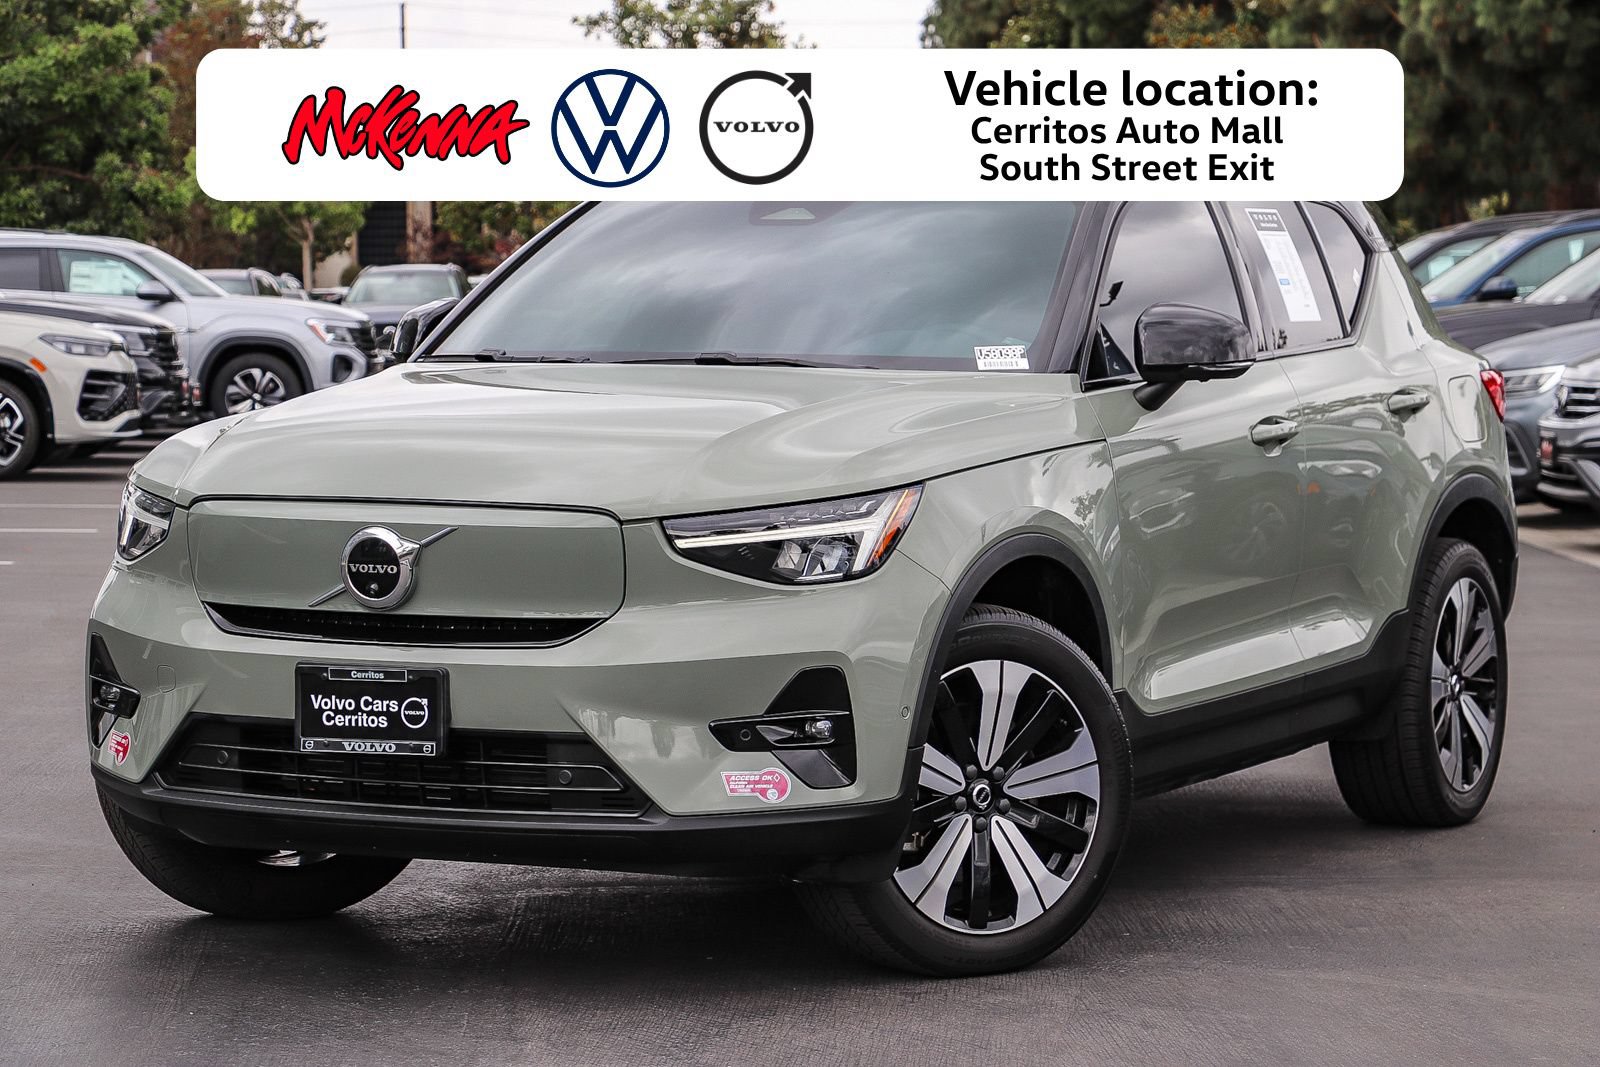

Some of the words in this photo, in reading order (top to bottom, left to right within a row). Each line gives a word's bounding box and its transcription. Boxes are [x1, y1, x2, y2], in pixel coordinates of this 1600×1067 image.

[348, 563, 398, 574] VOLVO
[351, 671, 384, 680] Cerritos
[310, 694, 355, 710] Volvo
[360, 696, 399, 713] Cars
[322, 711, 388, 728] Cerritos
[342, 741, 396, 753] VOLVO
